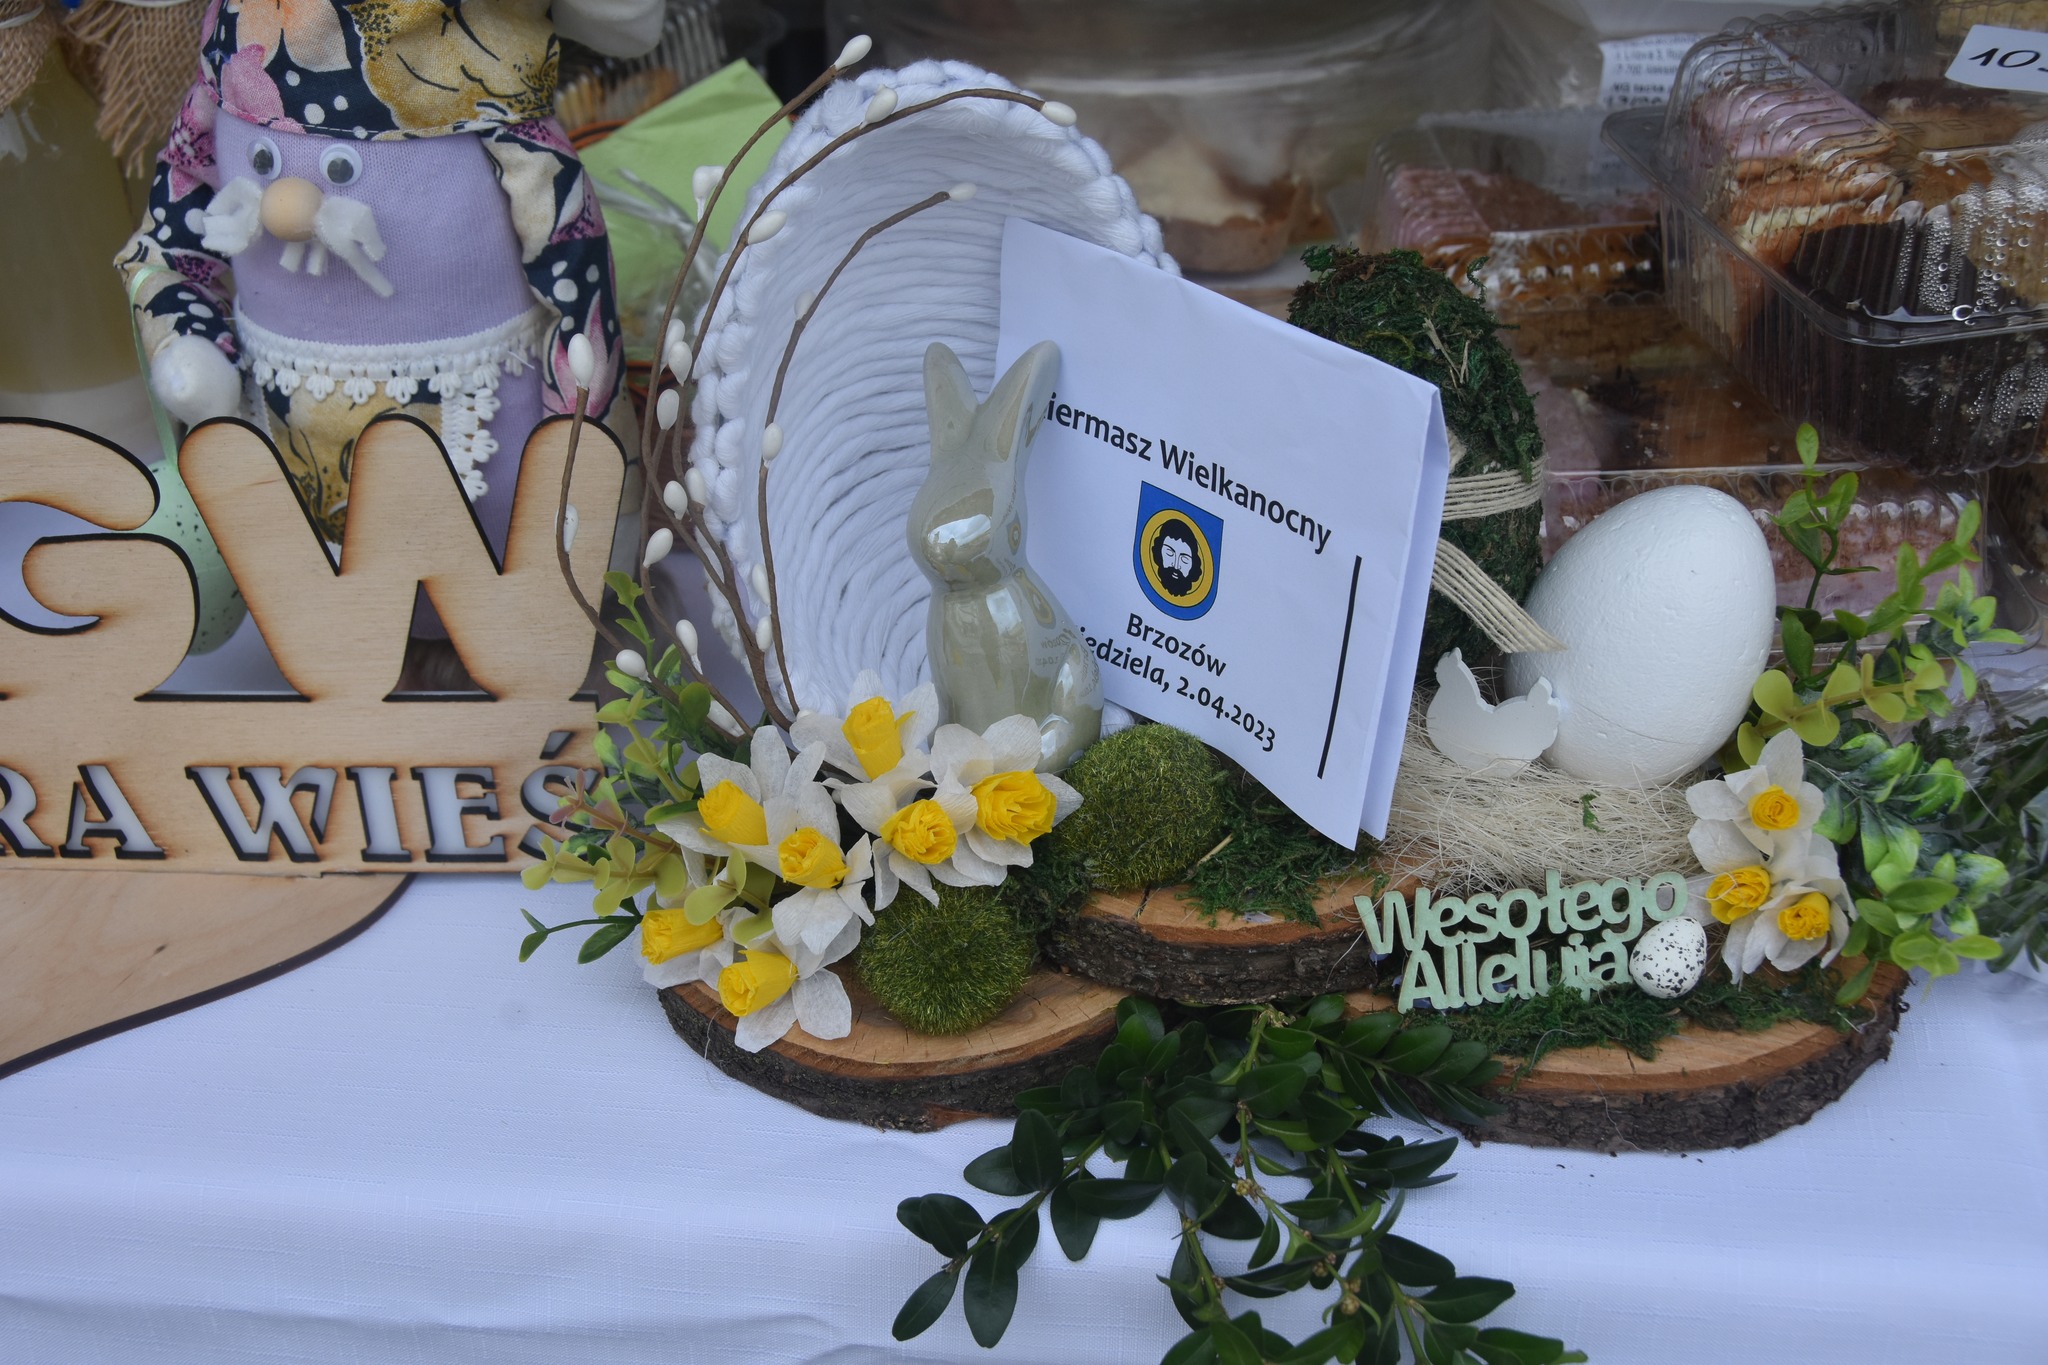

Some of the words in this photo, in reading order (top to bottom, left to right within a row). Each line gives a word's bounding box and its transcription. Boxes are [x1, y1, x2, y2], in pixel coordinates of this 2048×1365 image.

[1044, 391, 1153, 462] iermasz
[1159, 438, 1332, 555] Wielkanocny
[1126, 612, 1227, 677] Brzozów
[1176, 676, 1276, 752] 2.04.2023
[184, 730, 612, 863] WIEŚ
[1353, 868, 1689, 955] Wesołego
[1397, 932, 1635, 1014] Alleluja
